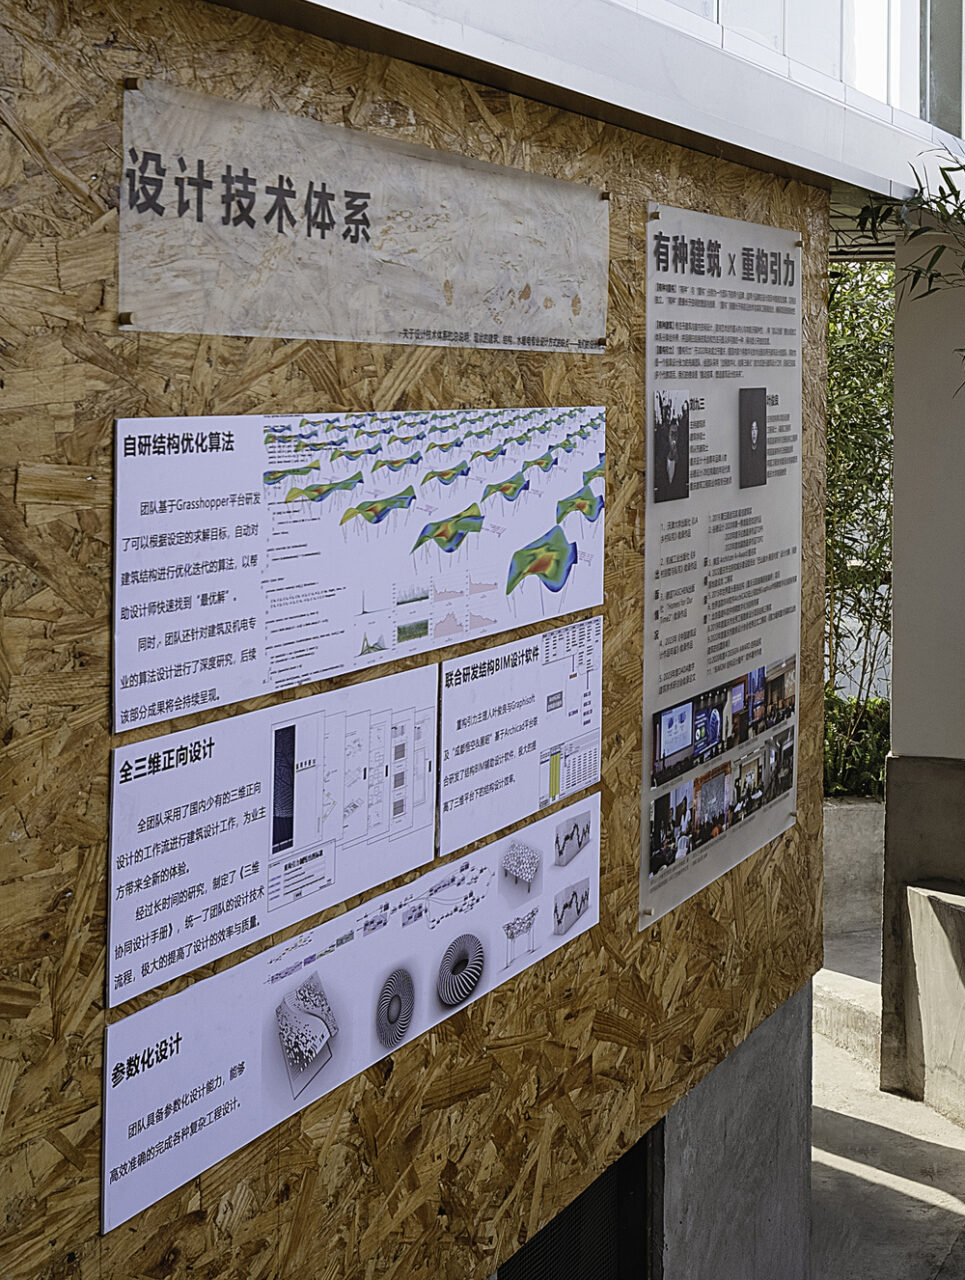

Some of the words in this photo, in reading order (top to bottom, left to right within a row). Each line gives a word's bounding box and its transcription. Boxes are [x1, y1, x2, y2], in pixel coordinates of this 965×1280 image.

[126, 147, 371, 243] 设计技术体系
[653, 231, 722, 278] 有种建筑
[741, 247, 795, 287] 重构引力
[123, 431, 235, 458] 自研结构优化算法
[140, 492, 261, 516] 团队基于Grasshopper平台研发
[445, 645, 540, 689] 联合研发结构BIM设计软件
[119, 736, 216, 785] 全三维正向设计
[111, 1032, 183, 1089] 参数化设计
